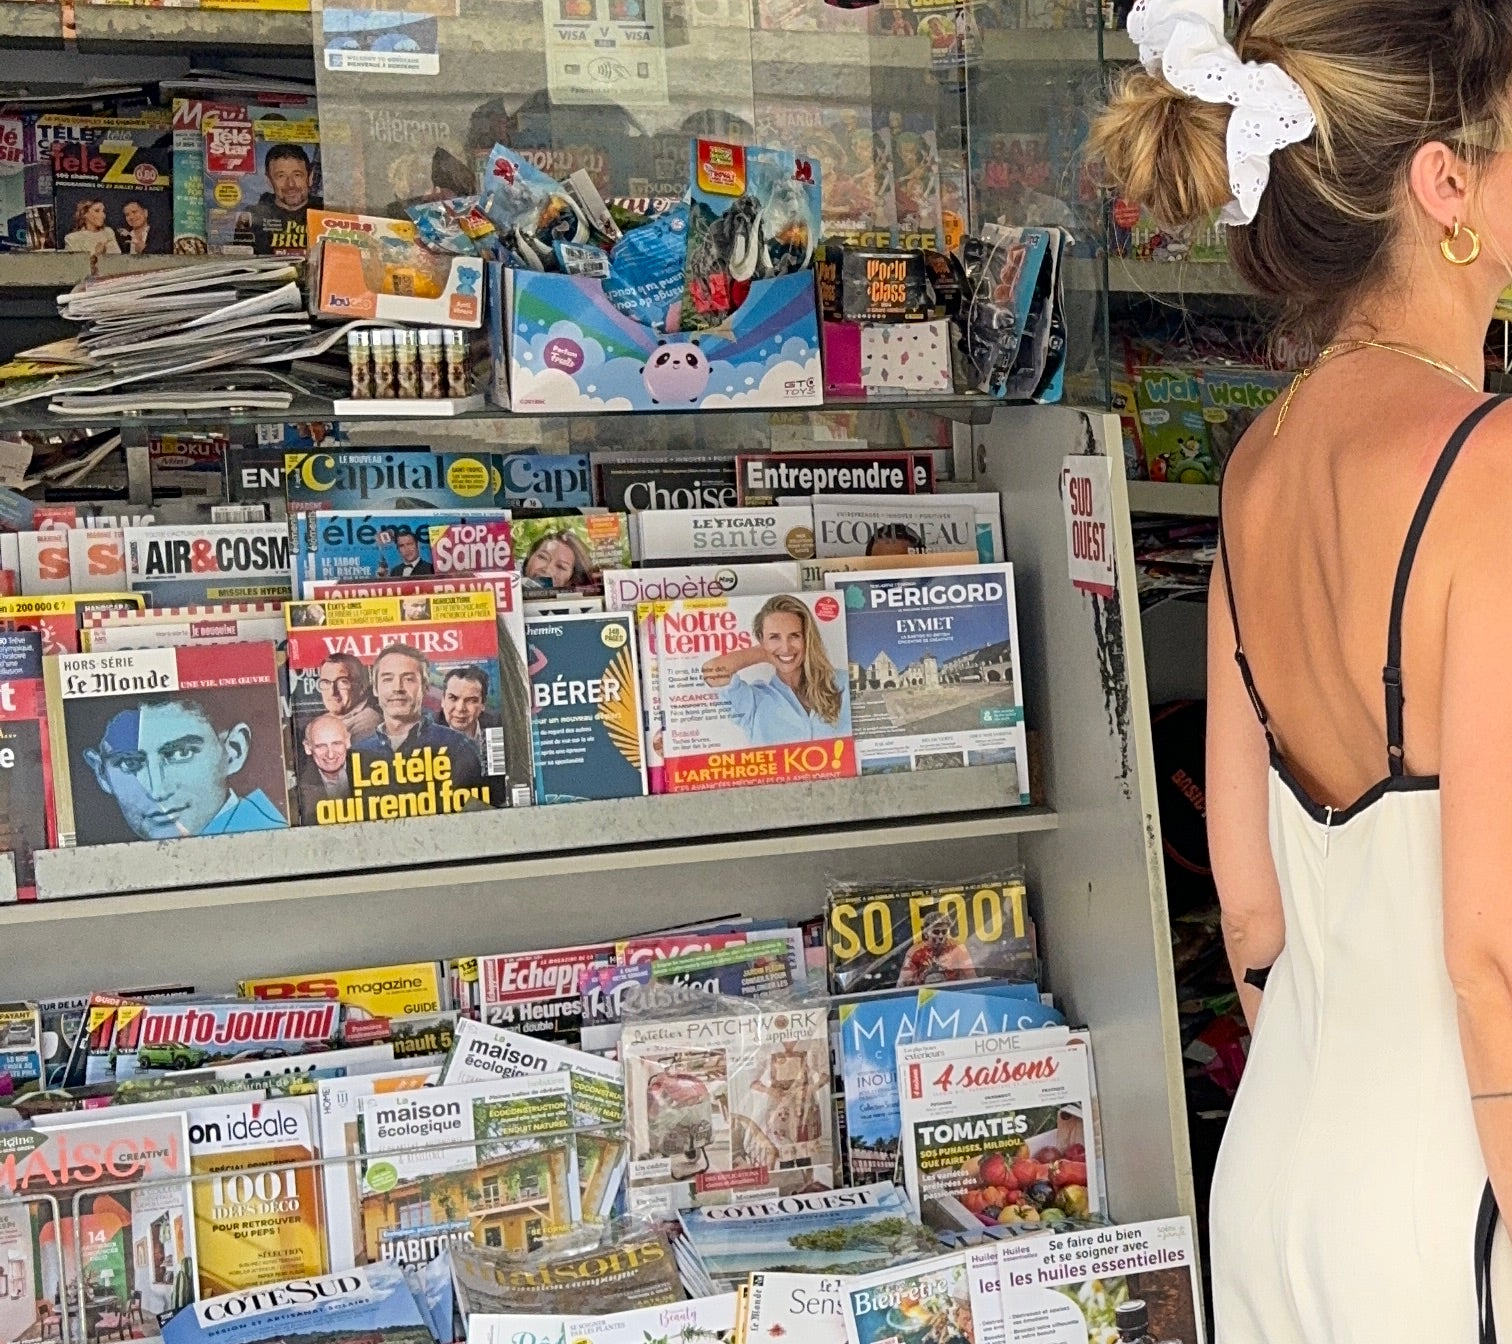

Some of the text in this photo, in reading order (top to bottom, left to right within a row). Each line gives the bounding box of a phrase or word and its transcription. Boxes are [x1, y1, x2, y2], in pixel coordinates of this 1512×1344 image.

[302, 453, 445, 499] Capital
[747, 462, 903, 493] Entreprendre
[1069, 476, 1093, 517] SUD
[451, 526, 487, 544] TOP
[1072, 521, 1107, 563] OUEST
[436, 534, 511, 572] Santé
[620, 575, 723, 602] Diabète
[663, 611, 736, 633] Notre
[896, 616, 955, 634] EYMET
[322, 629, 459, 656] VALEURS
[664, 630, 752, 656] temps
[64, 657, 134, 671] HORS SÉRIE
[64, 672, 170, 695] Le Monde
[352, 747, 451, 787] La télé
[708, 752, 735, 766] ON
[741, 750, 776, 765] MET
[675, 763, 778, 784] L'ARTHROSE
[317, 789, 365, 824] qui
[368, 786, 436, 819] rend
[831, 885, 1027, 959] SO FOOT
[346, 976, 422, 995] magazine
[404, 1002, 438, 1014] GUIDE
[490, 1001, 580, 1024] 24 Heures
[468, 1037, 548, 1072] maison
[974, 1035, 1020, 1053] HOME
[932, 1056, 1059, 1092] 4 saisons
[377, 1101, 461, 1124] maison
[378, 1119, 461, 1138] écologique
[918, 1115, 1028, 1144] TOMATES
[212, 1170, 299, 1201] 1001
[212, 1222, 238, 1232] POUR
[1043, 1240, 1149, 1265] et se soigner avec
[1049, 1229, 1142, 1251] Se faire du bien
[1010, 1248, 1185, 1287] les huiles essentielles
